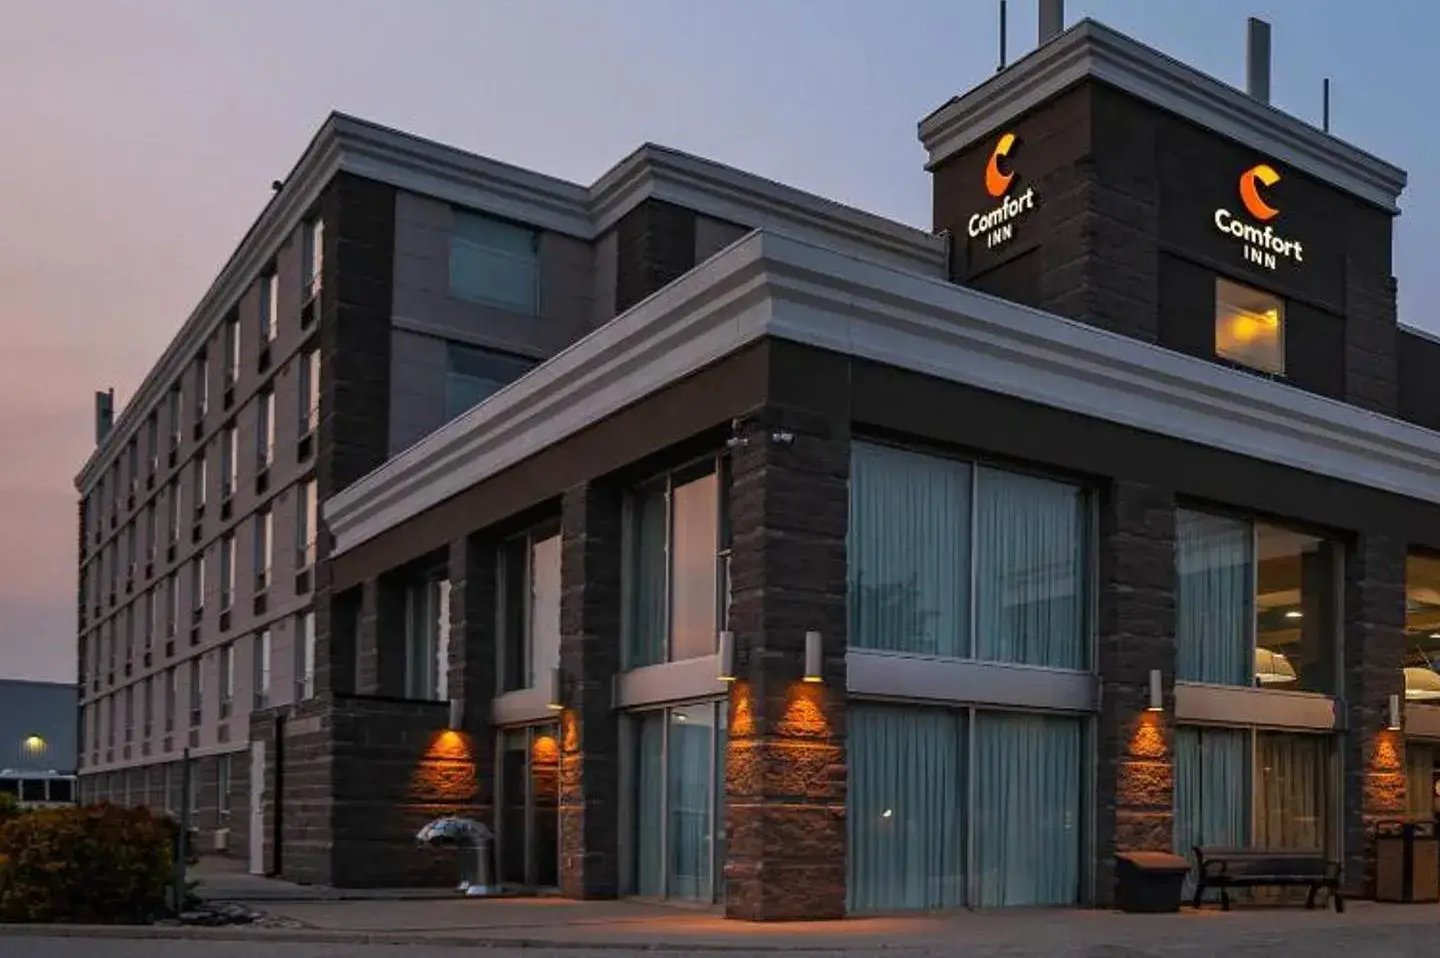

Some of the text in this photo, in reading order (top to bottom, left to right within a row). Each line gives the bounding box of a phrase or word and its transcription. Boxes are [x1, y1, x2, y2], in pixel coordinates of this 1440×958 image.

[968, 187, 1034, 238] Comfort
[987, 223, 1013, 249] INN
[1214, 208, 1303, 262] Comfort
[1243, 244, 1276, 270] INN
